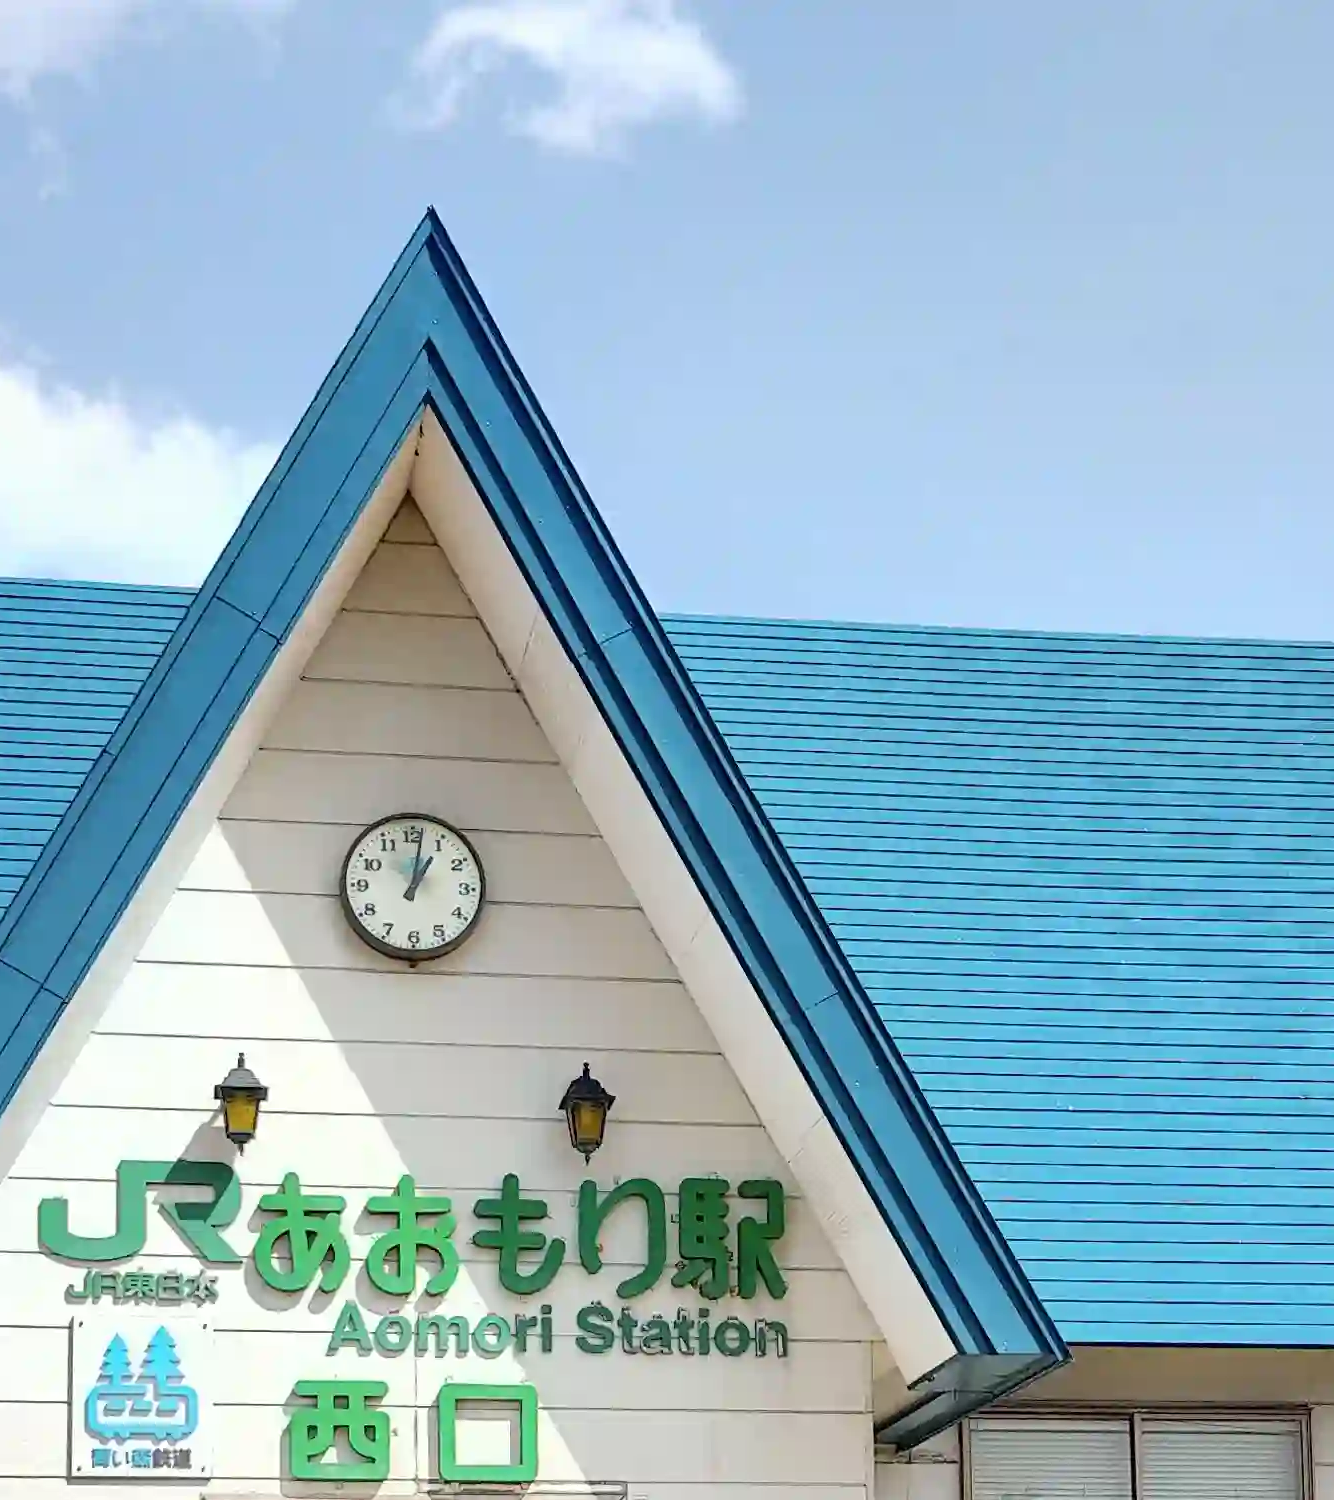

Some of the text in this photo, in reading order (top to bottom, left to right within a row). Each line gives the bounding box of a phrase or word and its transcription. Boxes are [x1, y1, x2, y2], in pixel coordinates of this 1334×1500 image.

[380, 839, 396, 851] 11
[435, 840, 442, 852] 1
[363, 858, 382, 871] 10
[451, 858, 463, 872] 2
[356, 879, 369, 892] 9
[459, 882, 470, 896] 3
[364, 903, 376, 916] 8
[451, 907, 463, 919] 4
[382, 922, 394, 936] 7
[433, 925, 445, 938] 5
[408, 931, 420, 944] 6
[38, 1160, 788, 1300] JR あおもり駅
[326, 1299, 789, 1358] Aomori Station
[289, 1380, 539, 1483] 西口
